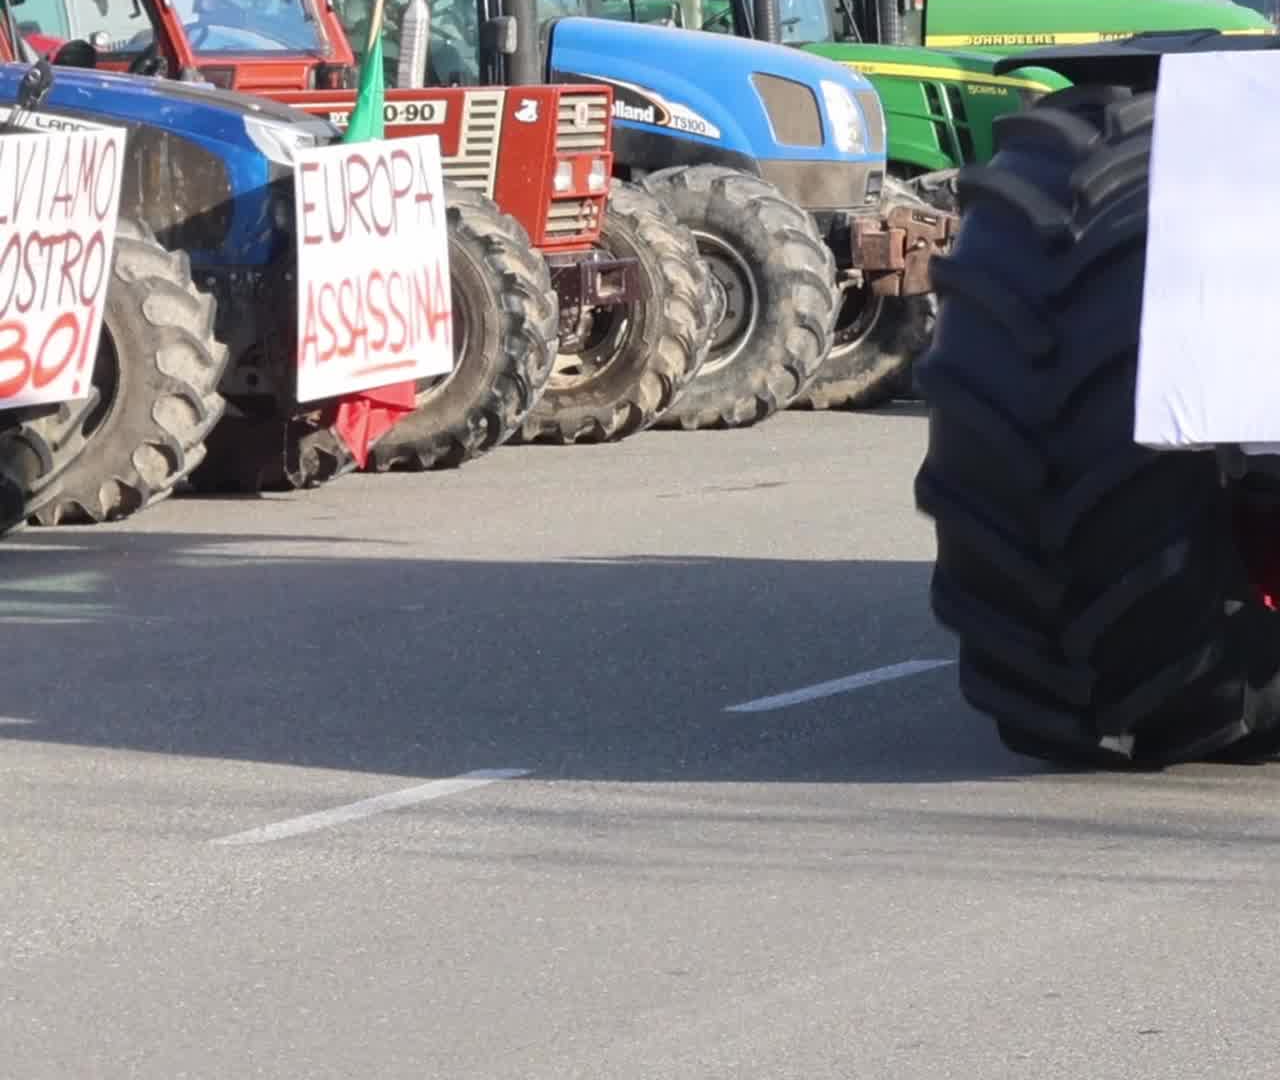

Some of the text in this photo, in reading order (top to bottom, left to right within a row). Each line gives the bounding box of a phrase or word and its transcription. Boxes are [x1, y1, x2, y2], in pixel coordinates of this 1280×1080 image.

[672, 114, 706, 134] TS100
[300, 144, 436, 246] EUROPA
[297, 260, 451, 366] ASSASSINA
